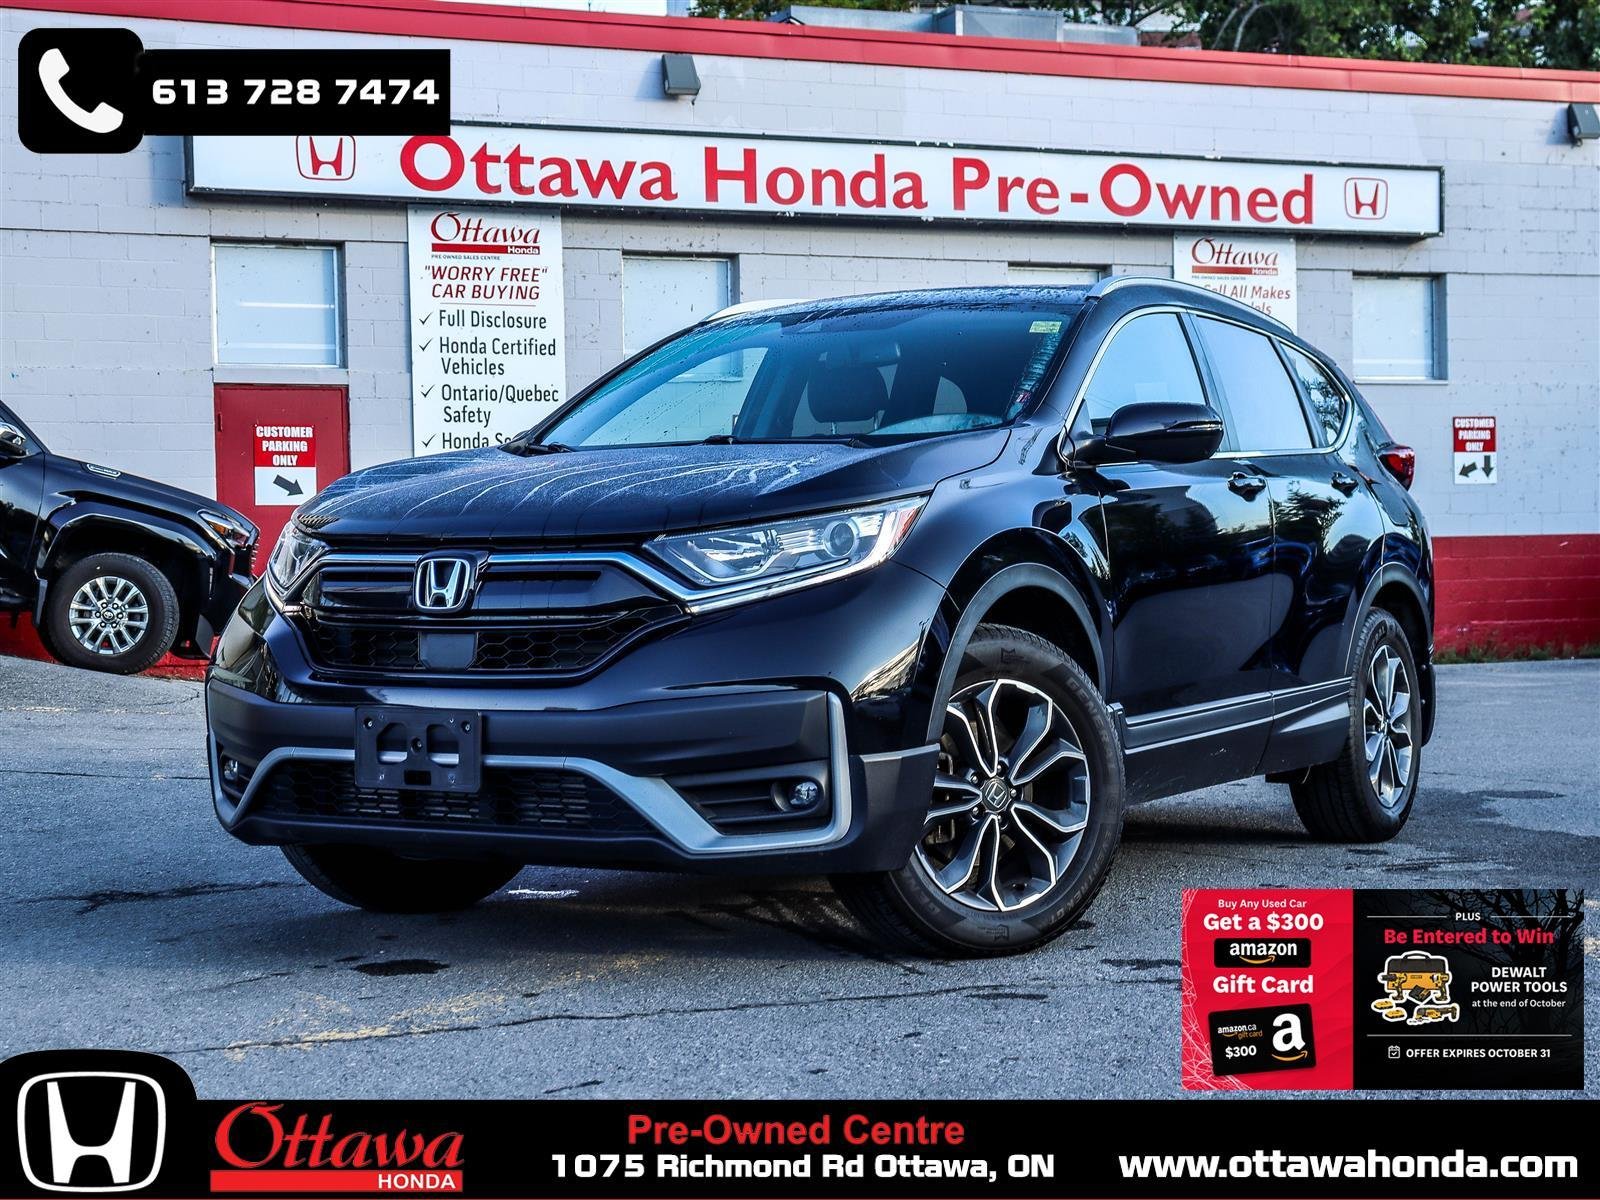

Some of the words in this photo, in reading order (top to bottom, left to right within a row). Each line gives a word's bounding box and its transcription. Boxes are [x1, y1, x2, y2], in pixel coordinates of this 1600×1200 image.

[399, 135, 679, 202] Ottawa
[703, 146, 929, 210] Honda
[951, 157, 1314, 224] Pre-Owned
[431, 212, 540, 244] Ottawa
[507, 246, 539, 255] Honda
[1191, 237, 1279, 266] Ottawa
[425, 265, 495, 280] "WORRY
[432, 284, 466, 298] CAR
[472, 284, 540, 300] BUYING
[1230, 285, 1247, 298] All
[1251, 286, 1291, 300] Makes
[439, 309, 465, 327] Full
[471, 310, 547, 329] Disclosure
[440, 336, 487, 354] Honda
[492, 337, 556, 356] Certified
[441, 357, 505, 375] Vehicles
[441, 384, 559, 403] Ontario/Quebec
[443, 405, 491, 428] Safety
[1454, 418, 1495, 428] CUSTOMER
[256, 426, 313, 438] CUSTOMER
[1458, 430, 1491, 440] PARKING
[262, 440, 308, 452] PARKING
[442, 432, 489, 449] Honda
[1465, 442, 1484, 452] ONLY
[272, 454, 298, 466] ONLY
